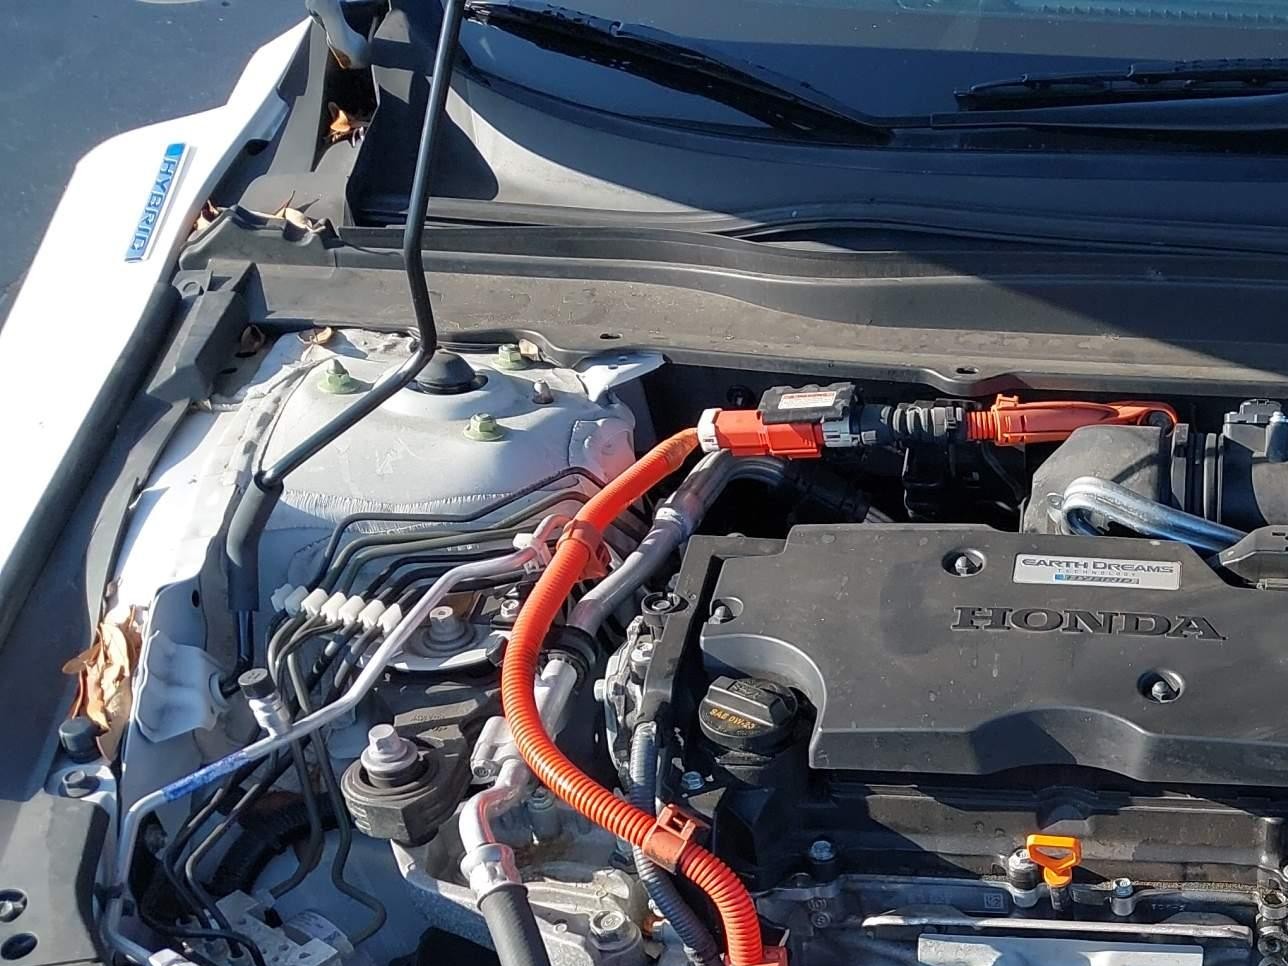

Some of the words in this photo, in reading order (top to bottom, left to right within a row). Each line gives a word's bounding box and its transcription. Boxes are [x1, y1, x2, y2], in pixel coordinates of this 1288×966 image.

[130, 158, 177, 251] HYBRID
[1021, 558, 1089, 570] EARTH
[1092, 561, 1175, 575] DREAMS
[949, 606, 1229, 642] HONDA
[709, 708, 729, 721] SAE
